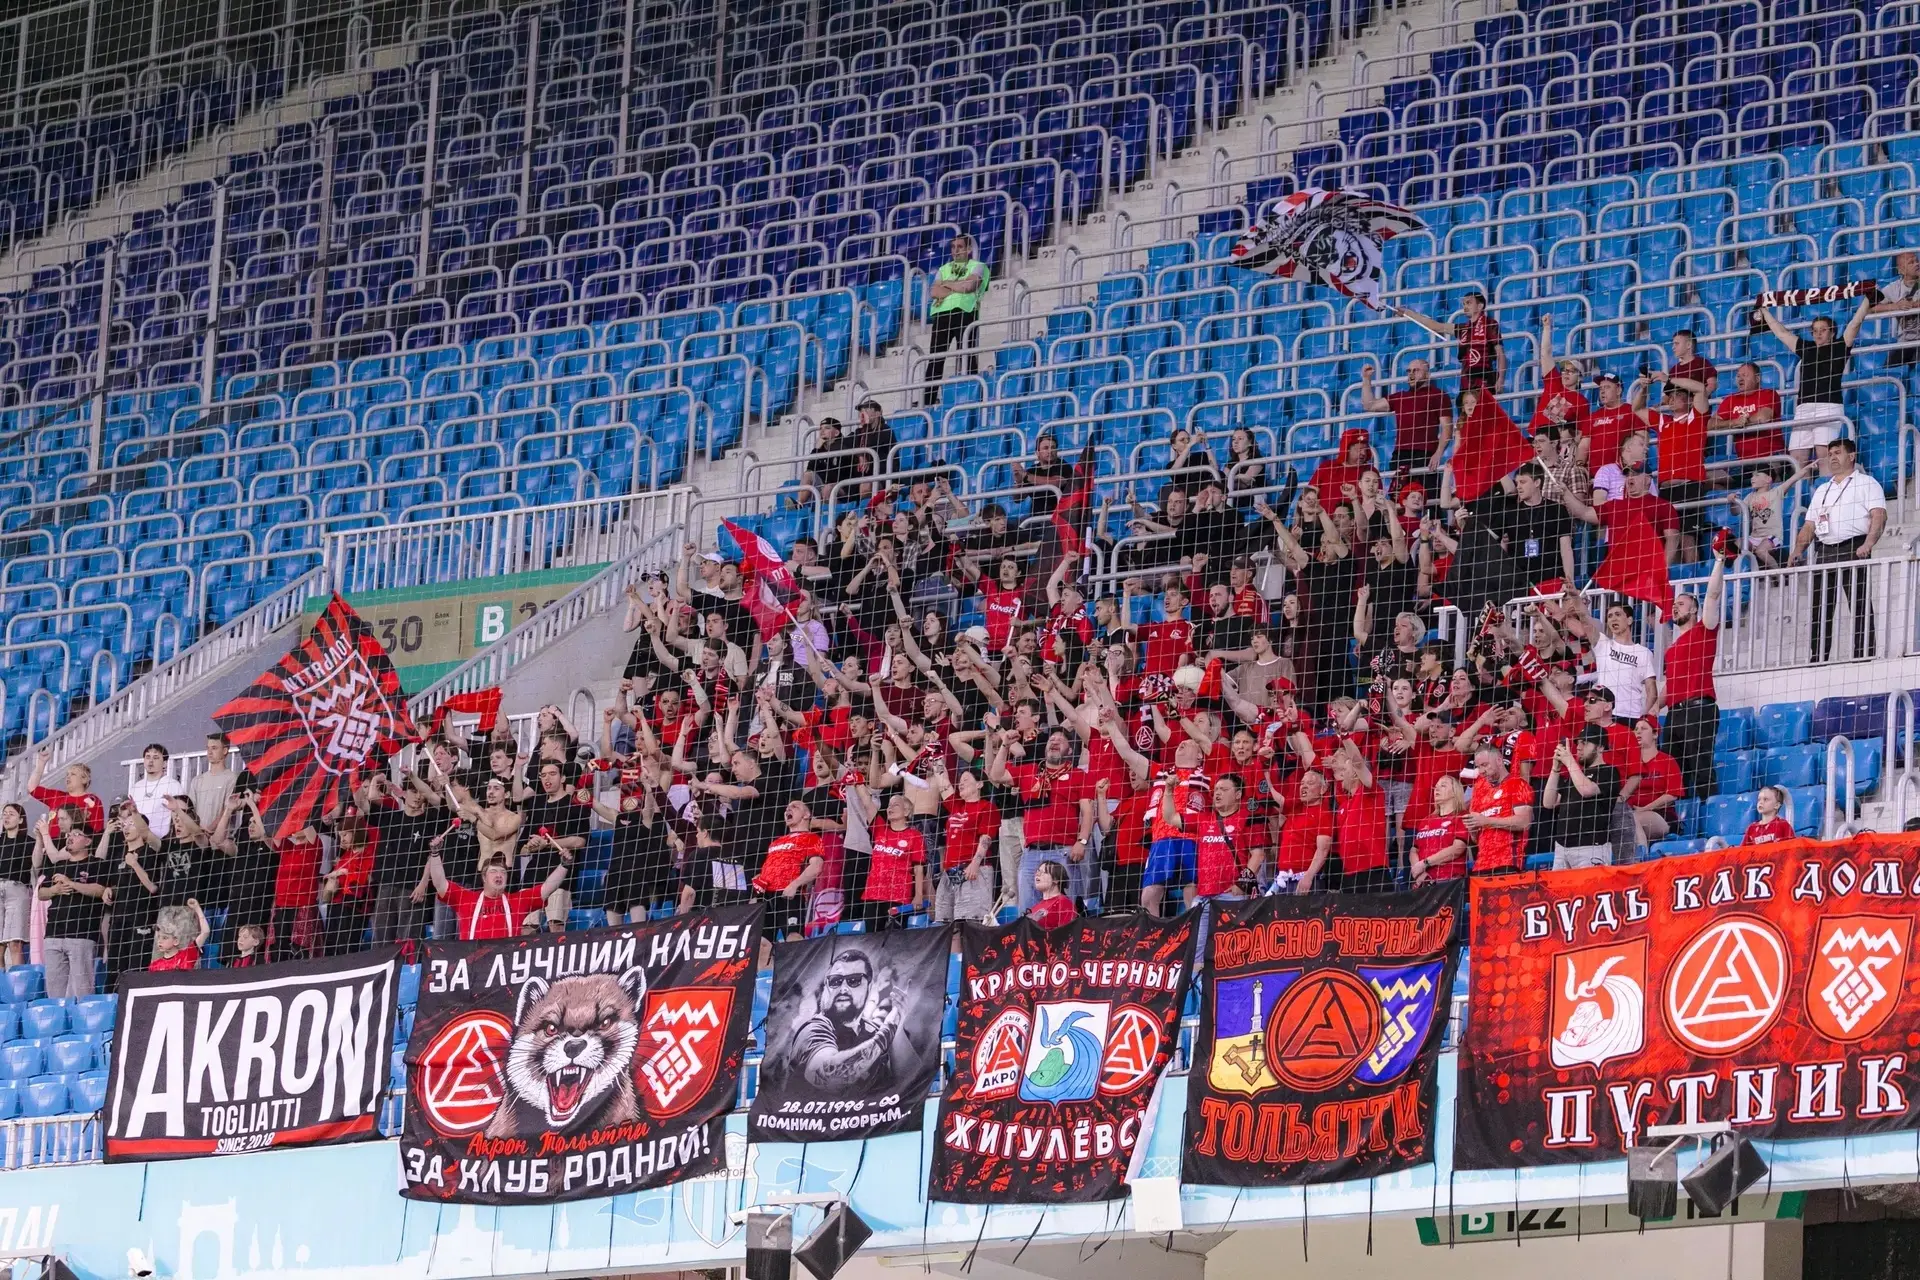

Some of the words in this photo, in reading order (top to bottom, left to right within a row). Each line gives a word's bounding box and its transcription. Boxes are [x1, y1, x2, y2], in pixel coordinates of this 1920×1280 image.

[363, 614, 424, 654] 30
[1609, 647, 1639, 665] ONTROL
[1522, 888, 1650, 942] БУДЬ
[1674, 861, 1774, 913] КАК
[1793, 860, 1920, 903] ДОМ
[428, 958, 471, 994] ЗА
[484, 931, 637, 988] ЛУЧШИЙ
[649, 923, 752, 969] КЛУБ!
[1214, 905, 1455, 970] КРАСНО-ЧЕРНЫЙ
[968, 960, 1184, 1002] КРАСНО-ЧЕРНЫЙ
[126, 980, 376, 1138] AKRON
[200, 1097, 302, 1137] TOGLIATTI
[756, 1114, 827, 1133] ПОМНИМ,
[778, 1099, 865, 1114] 28.07.1996
[1199, 1079, 1424, 1164] ТОЛЬЯТТИ
[215, 1136, 248, 1153] SINCE
[246, 1131, 276, 1150] 2018
[406, 1147, 444, 1188] ЗА
[458, 1158, 550, 1194] КЛУБ
[562, 1122, 711, 1191] РОДНОЙ!
[467, 1131, 529, 1162] Акрон
[535, 1119, 651, 1158] Тольятти
